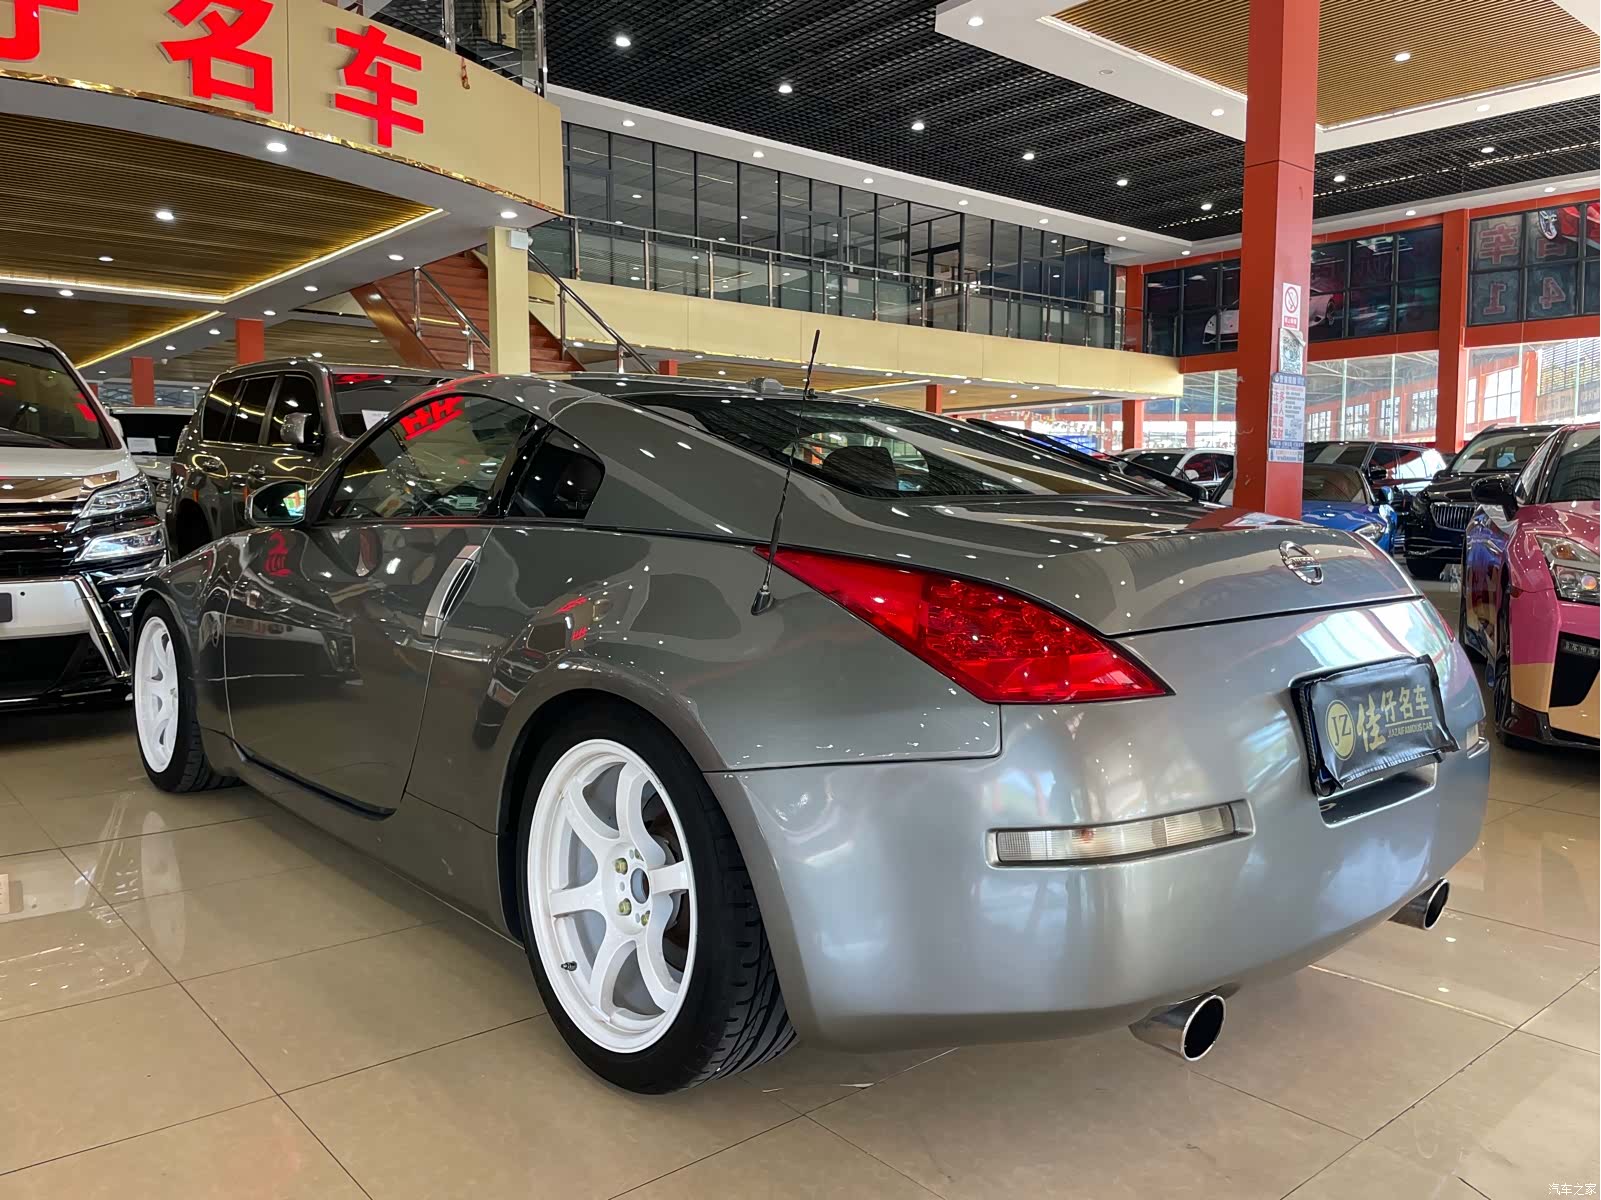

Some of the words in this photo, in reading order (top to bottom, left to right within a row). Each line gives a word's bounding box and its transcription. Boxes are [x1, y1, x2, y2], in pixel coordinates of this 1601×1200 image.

[0, 0, 424, 147] 名车
[1331, 713, 1352, 746] JZ
[1357, 684, 1430, 752] 佳仔名车
